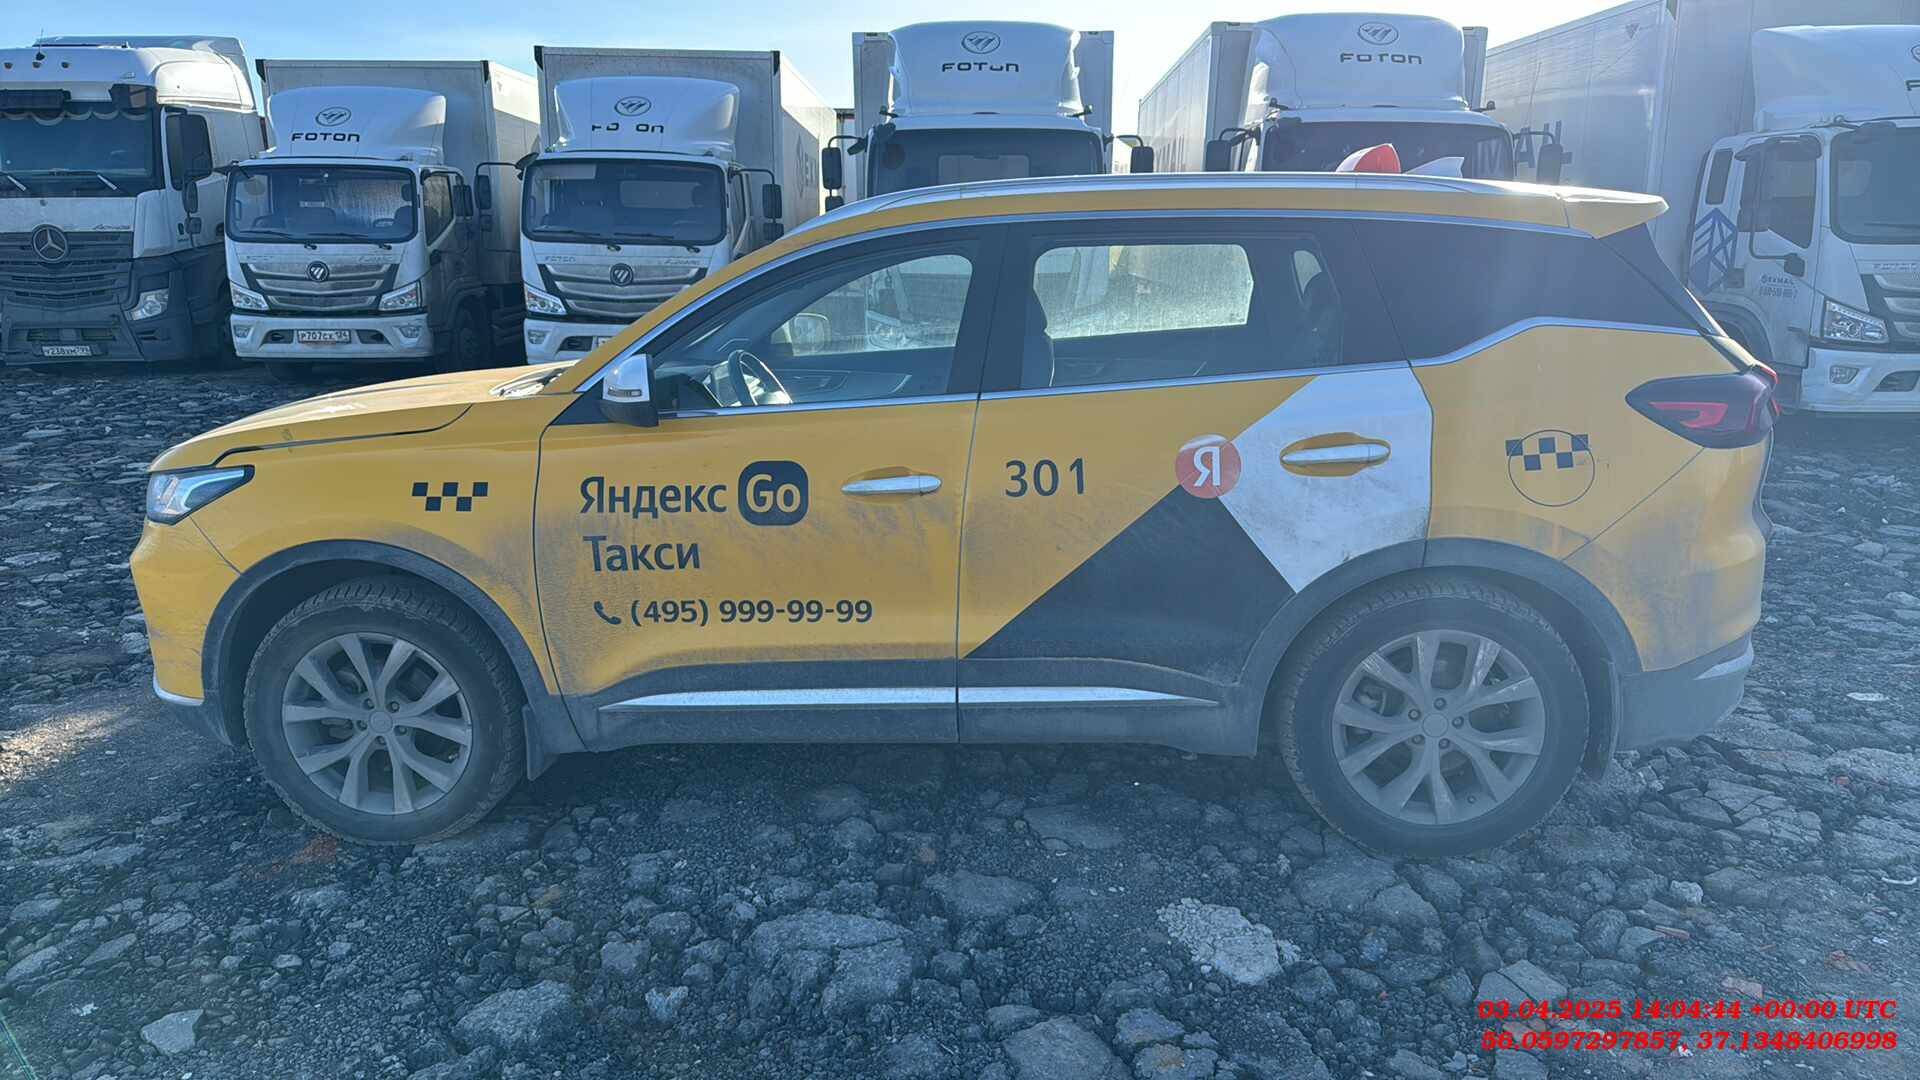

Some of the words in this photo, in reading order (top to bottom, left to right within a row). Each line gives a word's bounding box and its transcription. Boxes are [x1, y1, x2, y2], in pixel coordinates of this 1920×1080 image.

[1340, 52, 1423, 65] FOTON
[291, 132, 361, 143] FOTON
[1004, 457, 1086, 498] 301
[1193, 446, 1221, 488] Я
[580, 476, 728, 519] Яндекс
[744, 472, 803, 515] Go
[582, 535, 701, 572] Такси
[630, 598, 710, 627] (495)
[718, 598, 873, 623] 999-99-99
